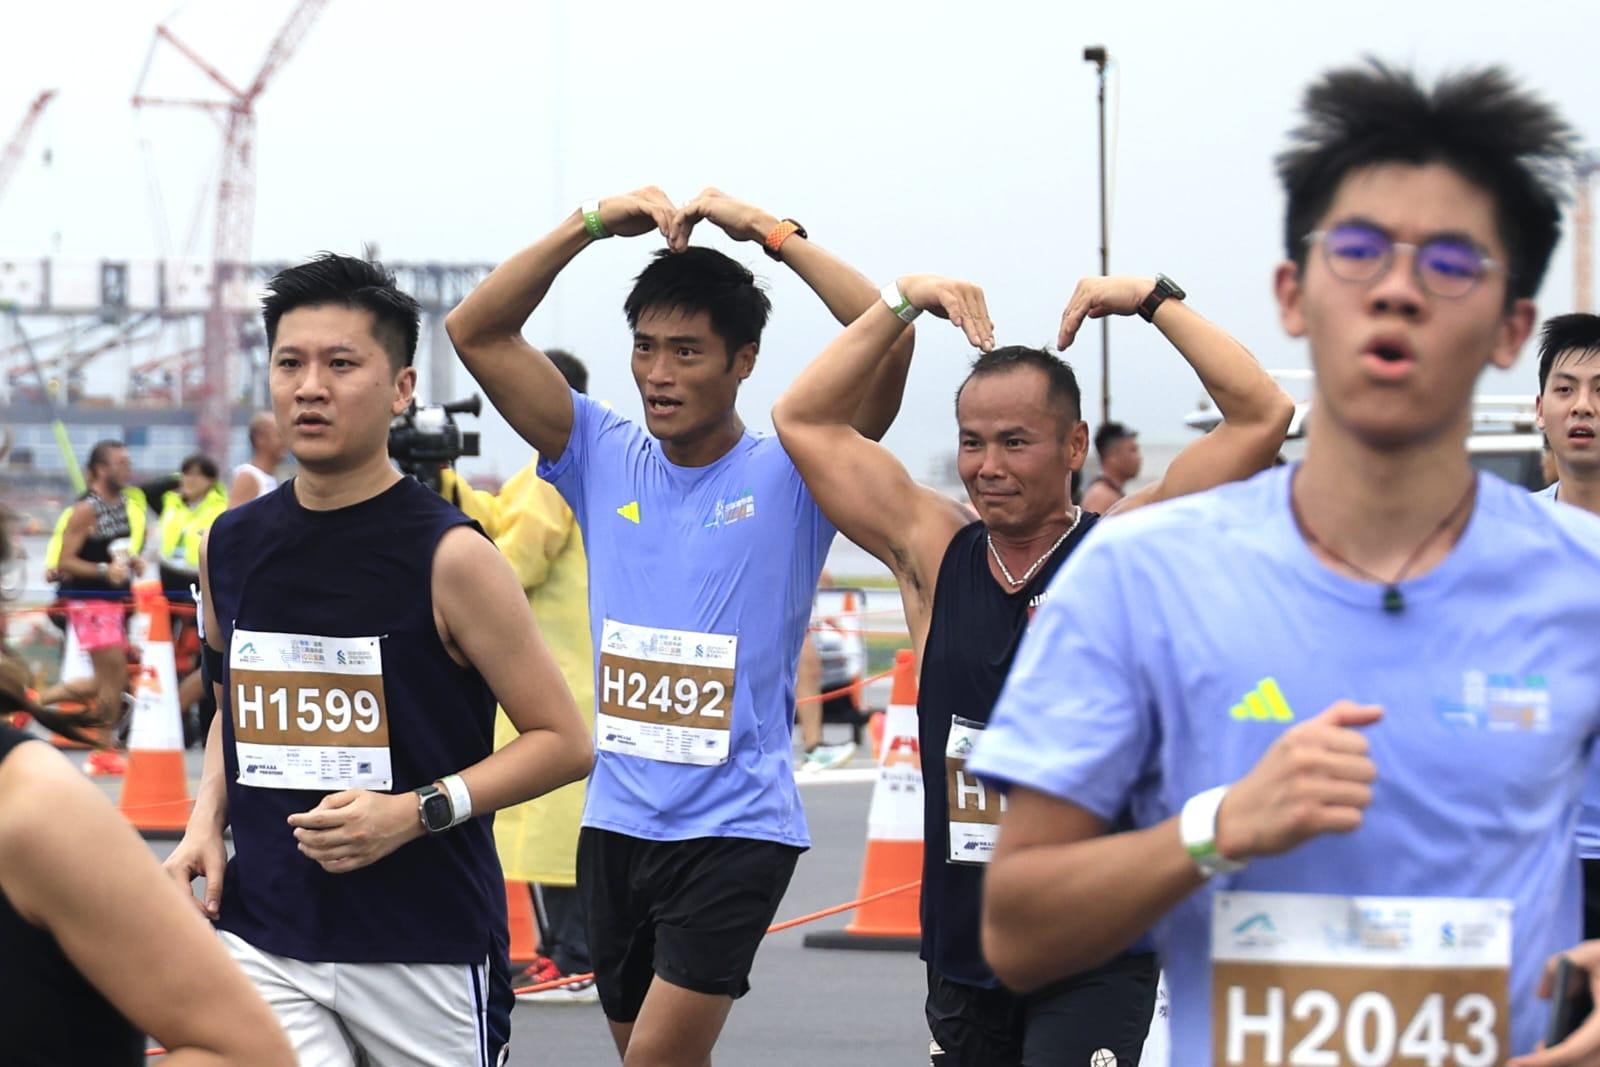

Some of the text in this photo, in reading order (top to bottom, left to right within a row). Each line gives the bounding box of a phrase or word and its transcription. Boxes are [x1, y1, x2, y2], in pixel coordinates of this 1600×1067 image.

[237, 683, 380, 733] H1599
[603, 665, 725, 718] H2492
[1226, 985, 1499, 1067] H2043
